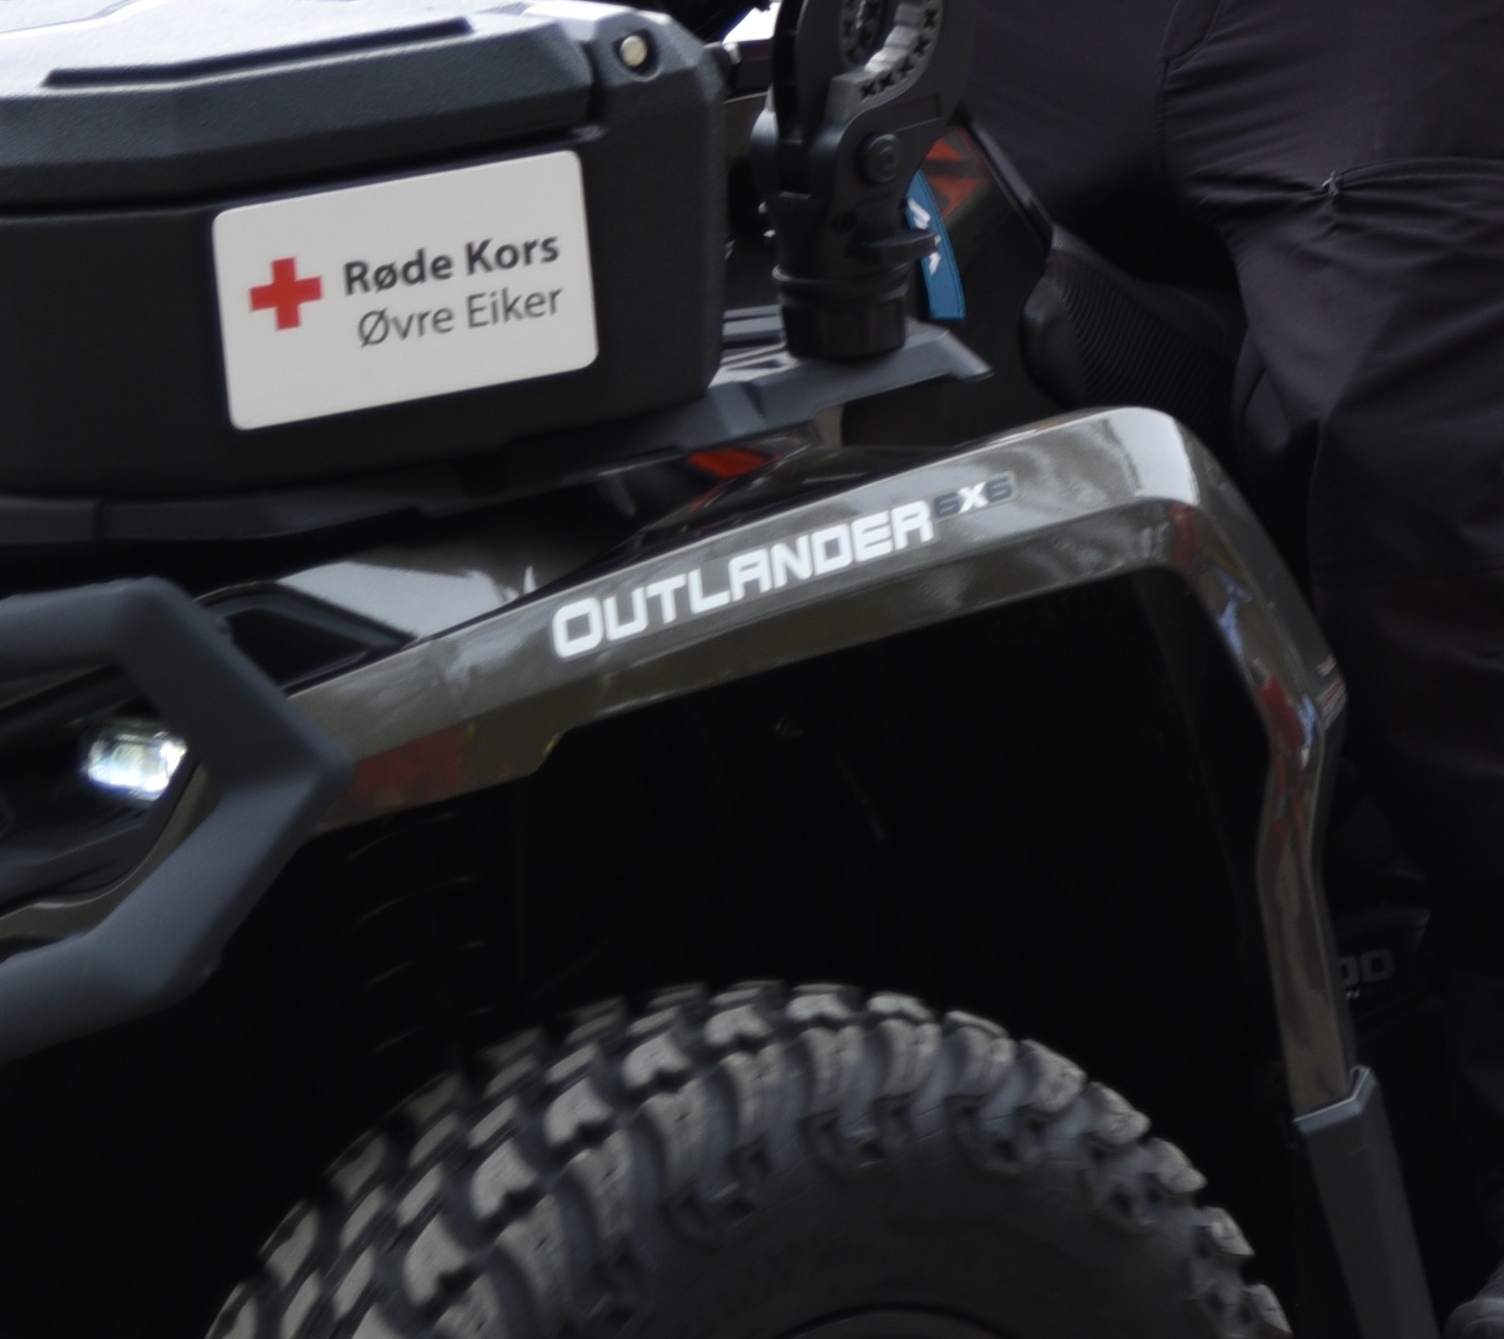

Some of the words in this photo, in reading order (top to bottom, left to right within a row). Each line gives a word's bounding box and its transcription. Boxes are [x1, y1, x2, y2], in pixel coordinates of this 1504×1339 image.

[343, 247, 454, 297] Røde
[464, 236, 561, 276] Kors
[358, 307, 455, 348] Øvre
[466, 286, 564, 330] Eiker
[552, 501, 935, 659] OUTLANDER
